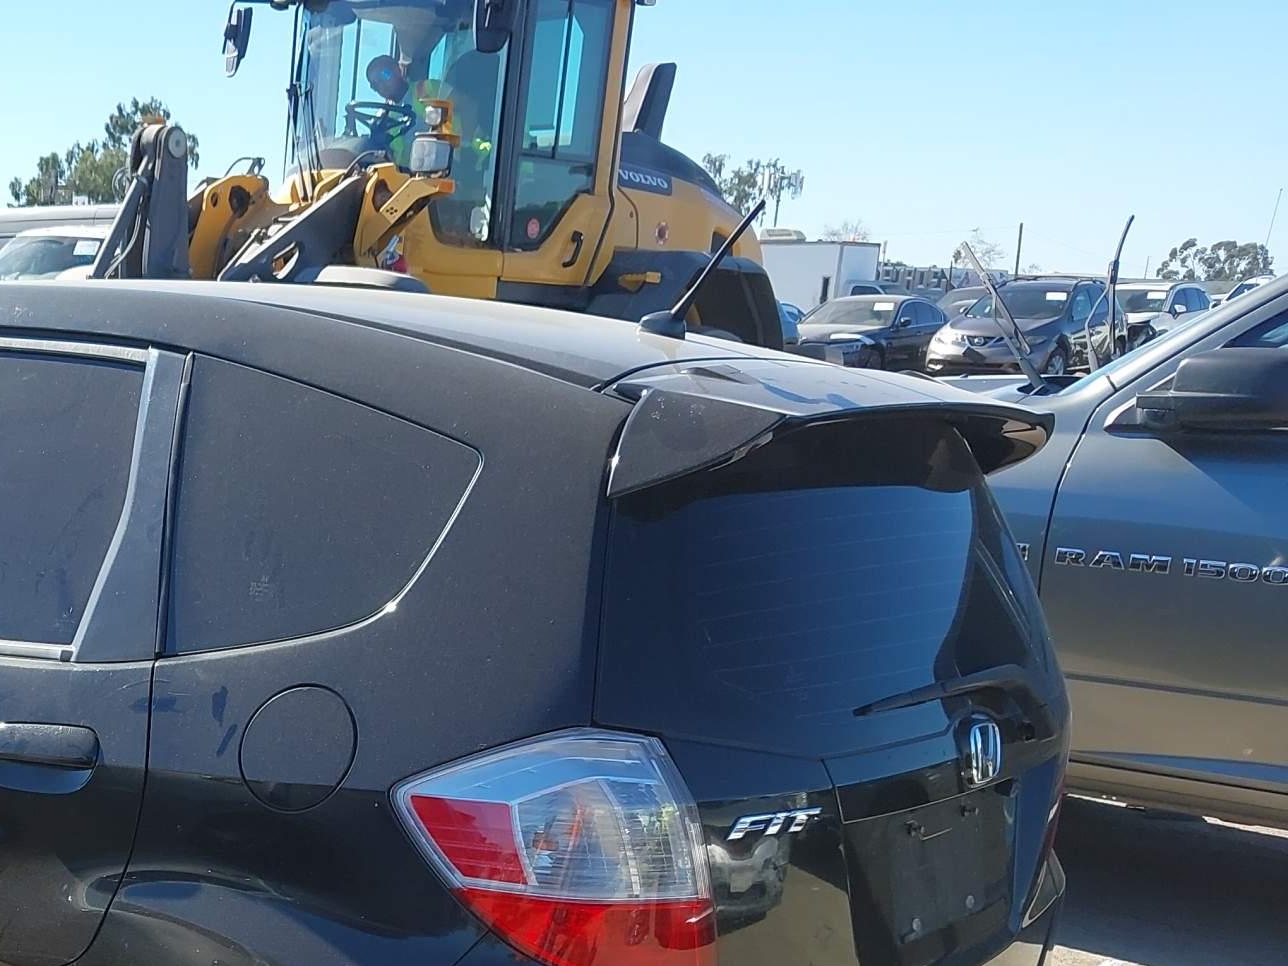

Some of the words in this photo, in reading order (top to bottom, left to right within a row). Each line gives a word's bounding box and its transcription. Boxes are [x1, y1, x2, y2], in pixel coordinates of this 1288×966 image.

[619, 168, 669, 189] VOLVO
[1054, 547, 1173, 574] RAM
[1183, 558, 1288, 586] 1500
[726, 807, 823, 841] FIT
